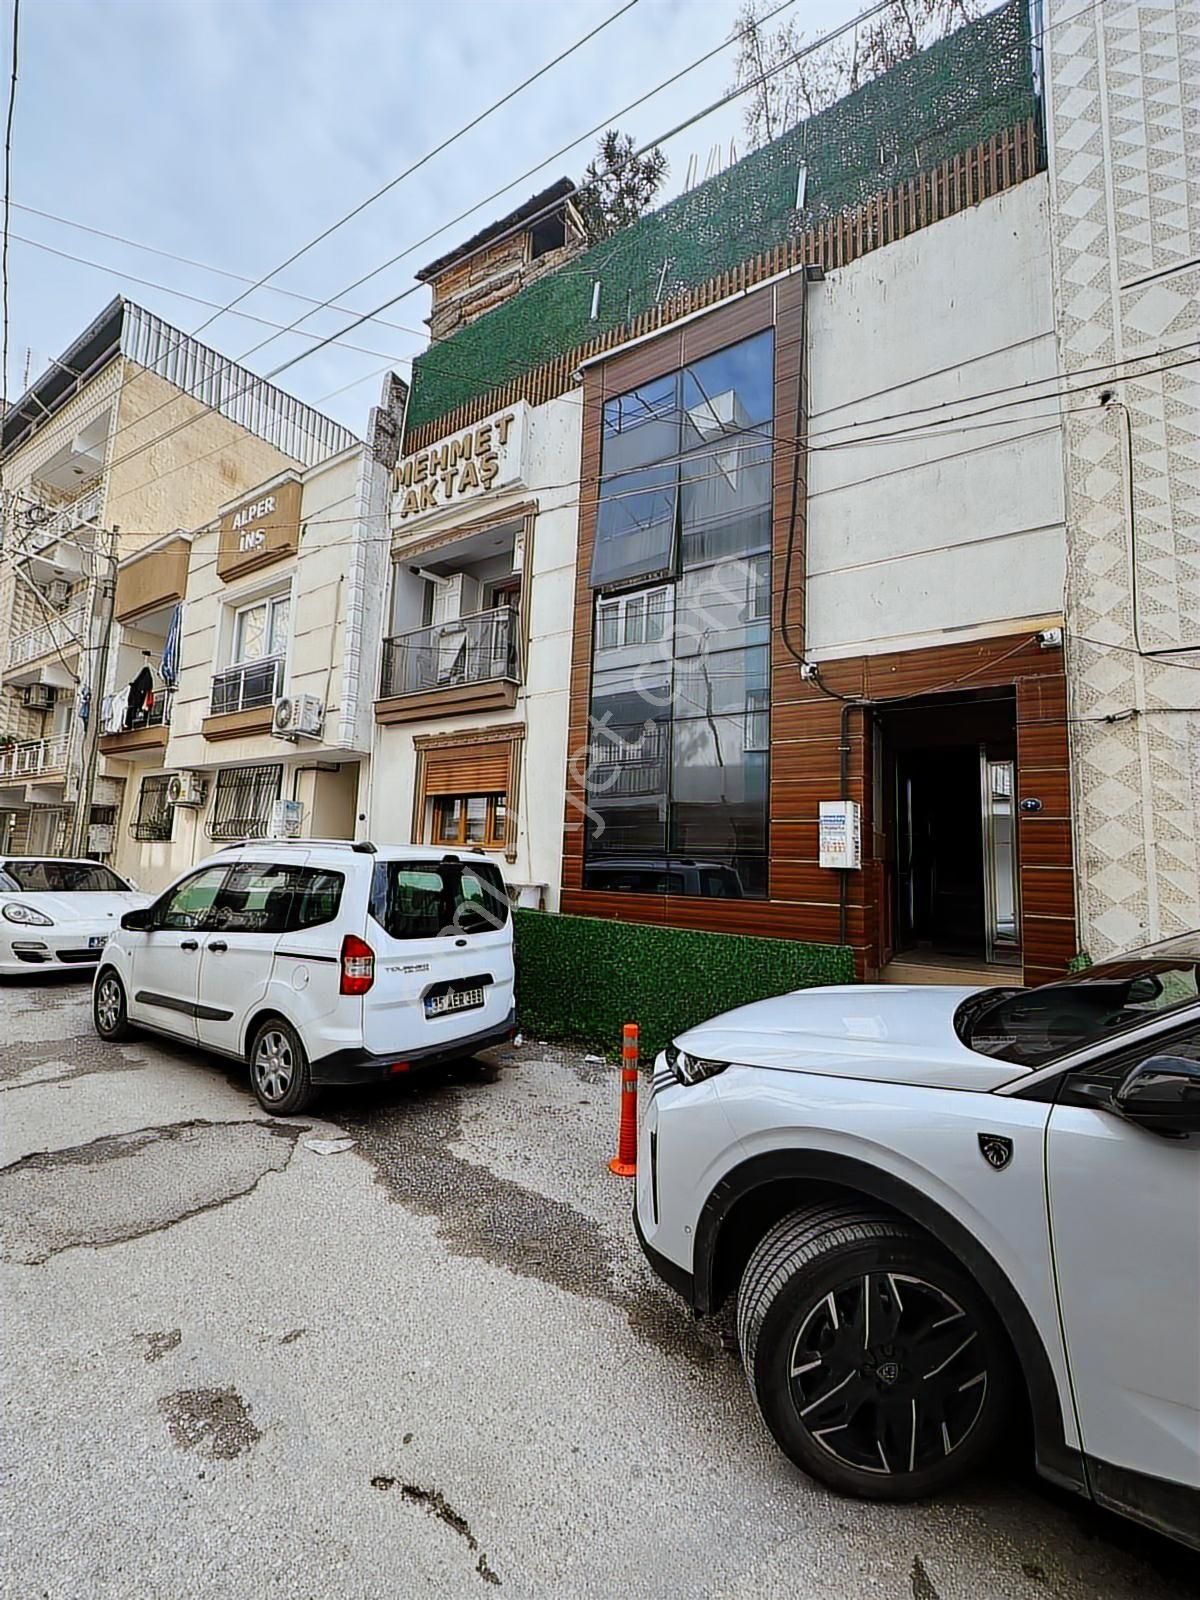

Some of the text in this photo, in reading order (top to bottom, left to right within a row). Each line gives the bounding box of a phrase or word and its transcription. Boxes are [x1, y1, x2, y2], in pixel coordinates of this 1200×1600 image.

[392, 413, 515, 492] MEHMET
[400, 452, 499, 518] AKTAŞ
[231, 496, 276, 530] ALPER
